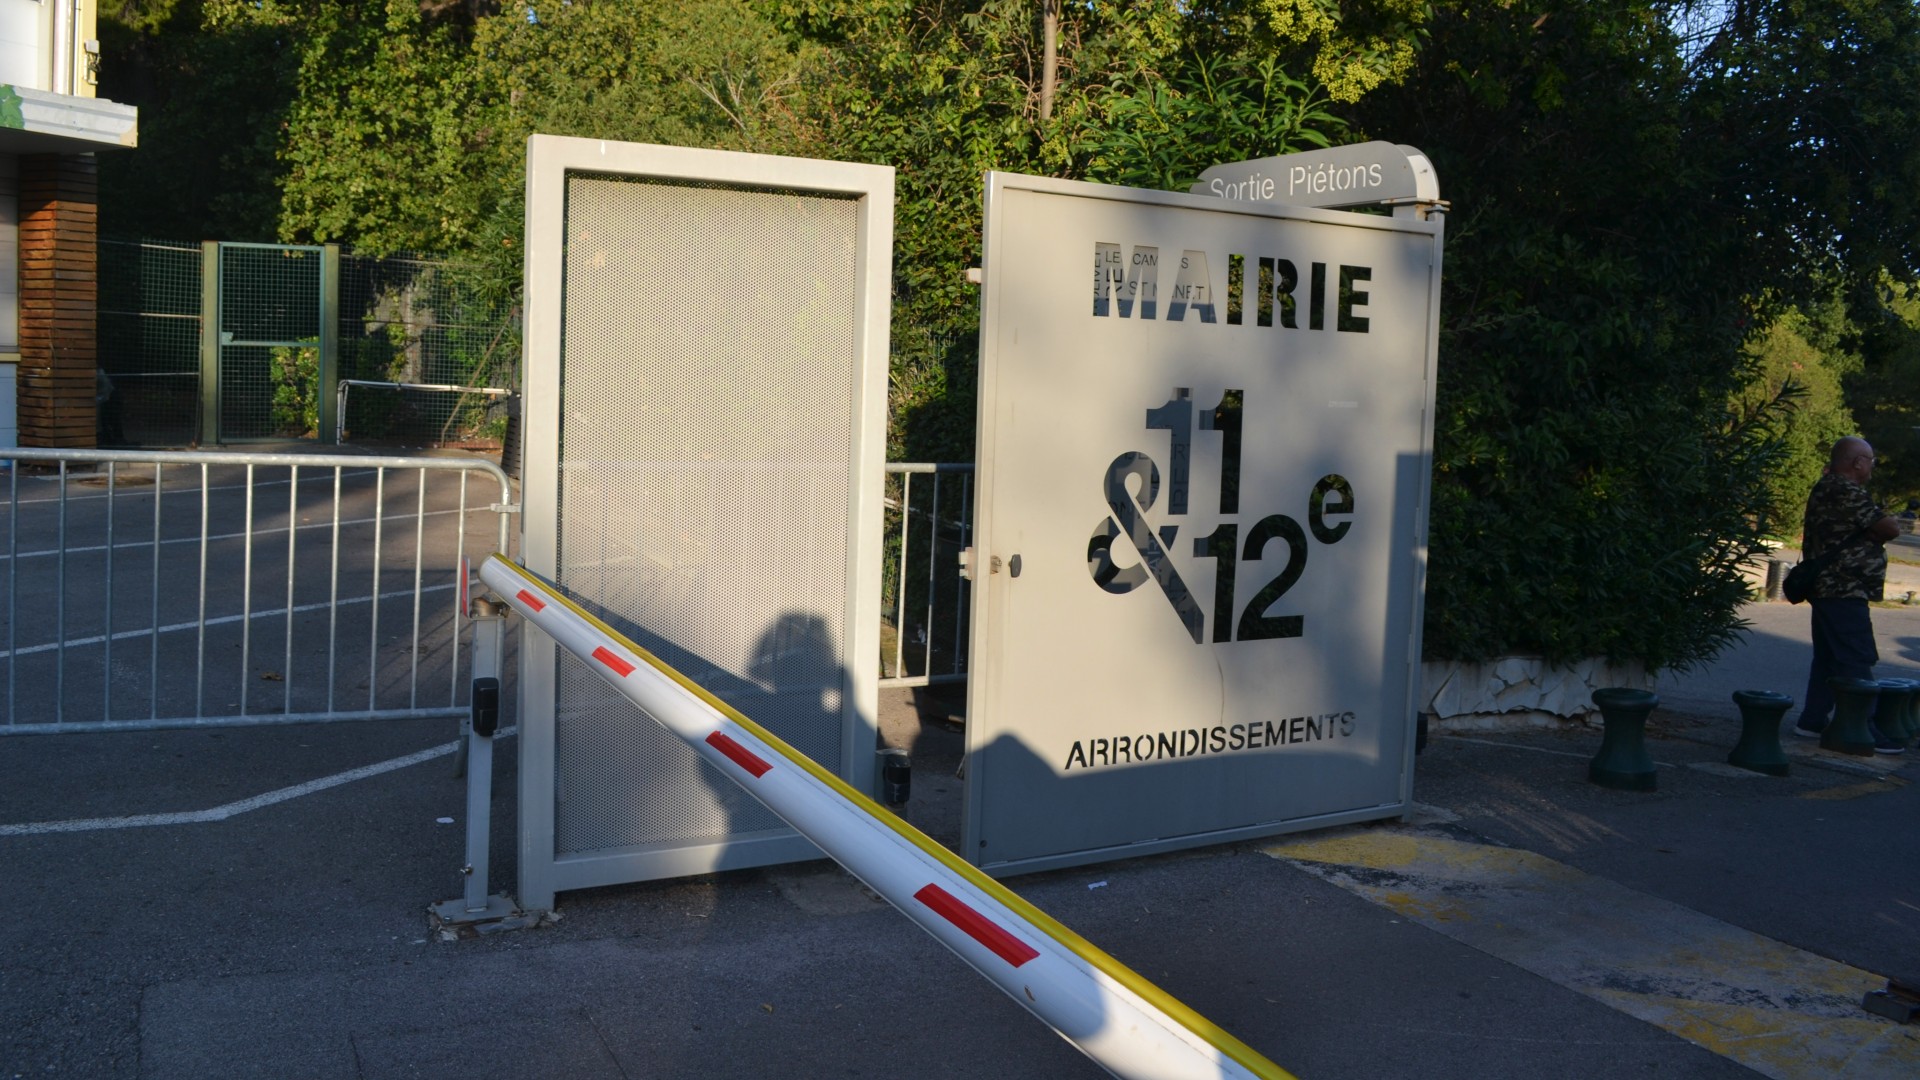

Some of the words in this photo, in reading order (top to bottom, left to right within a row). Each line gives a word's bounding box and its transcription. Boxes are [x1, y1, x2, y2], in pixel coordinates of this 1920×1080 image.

[1210, 172, 1275, 201] Sortie
[1289, 162, 1383, 197] Piétons
[1092, 241, 1372, 334] MAIRIE
[1146, 387, 1244, 515] 11
[1087, 451, 1204, 644] &
[1064, 711, 1357, 770] ARRONDISSEMENTS
